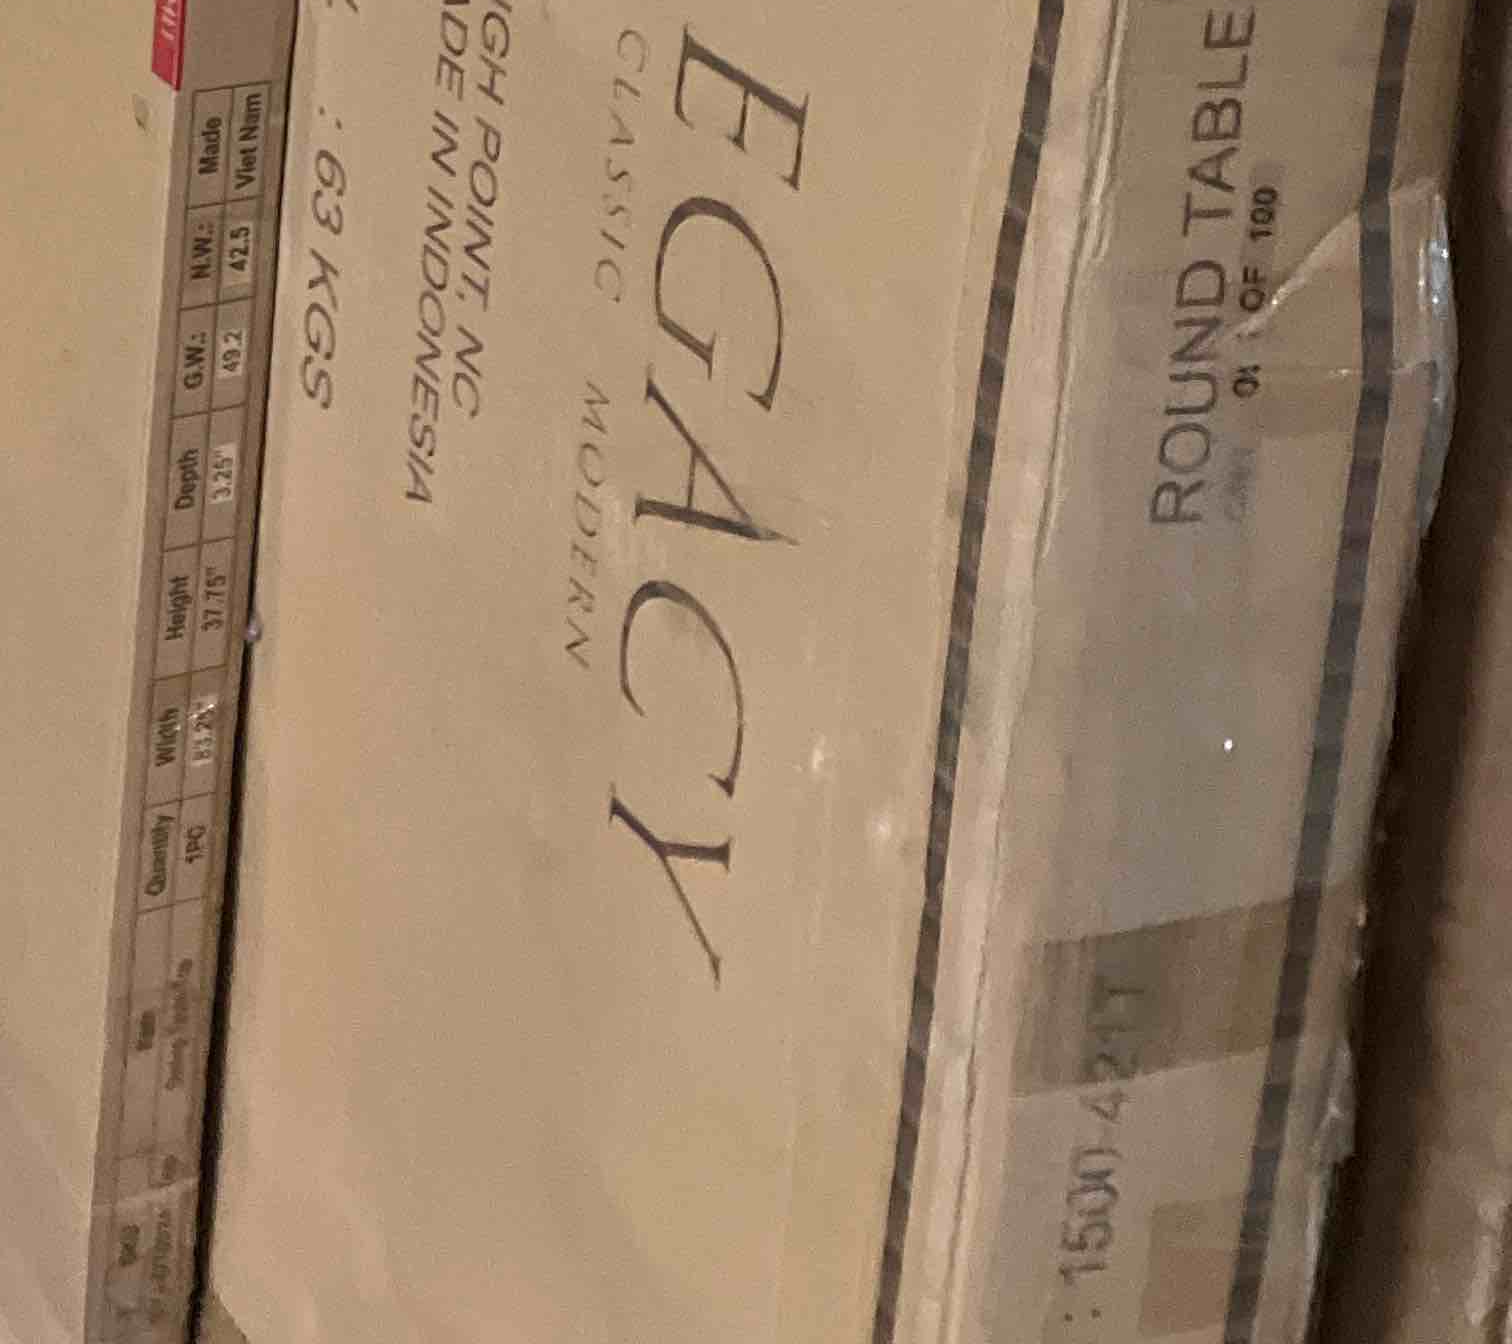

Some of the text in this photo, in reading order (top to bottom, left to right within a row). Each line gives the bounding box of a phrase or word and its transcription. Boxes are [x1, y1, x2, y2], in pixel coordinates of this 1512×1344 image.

[197, 116, 224, 175] Made
[234, 91, 264, 191] Viet Nam
[429, 111, 464, 170] IN
[1180, 7, 1256, 239] TABLE
[310, 149, 348, 226] 63
[229, 224, 250, 273] 42.5
[1238, 265, 1267, 314] OF
[221, 331, 243, 374] 49.2
[301, 249, 343, 410] KGS
[405, 187, 456, 506] INDONESIA
[564, 27, 649, 670] CLASSIC MODERN
[451, 328, 486, 419] NC
[1148, 259, 1227, 526] ROUND
[172, 447, 200, 512] Depth
[163, 574, 193, 642] Height
[153, 707, 181, 769] Width
[144, 815, 176, 897] Quantity
